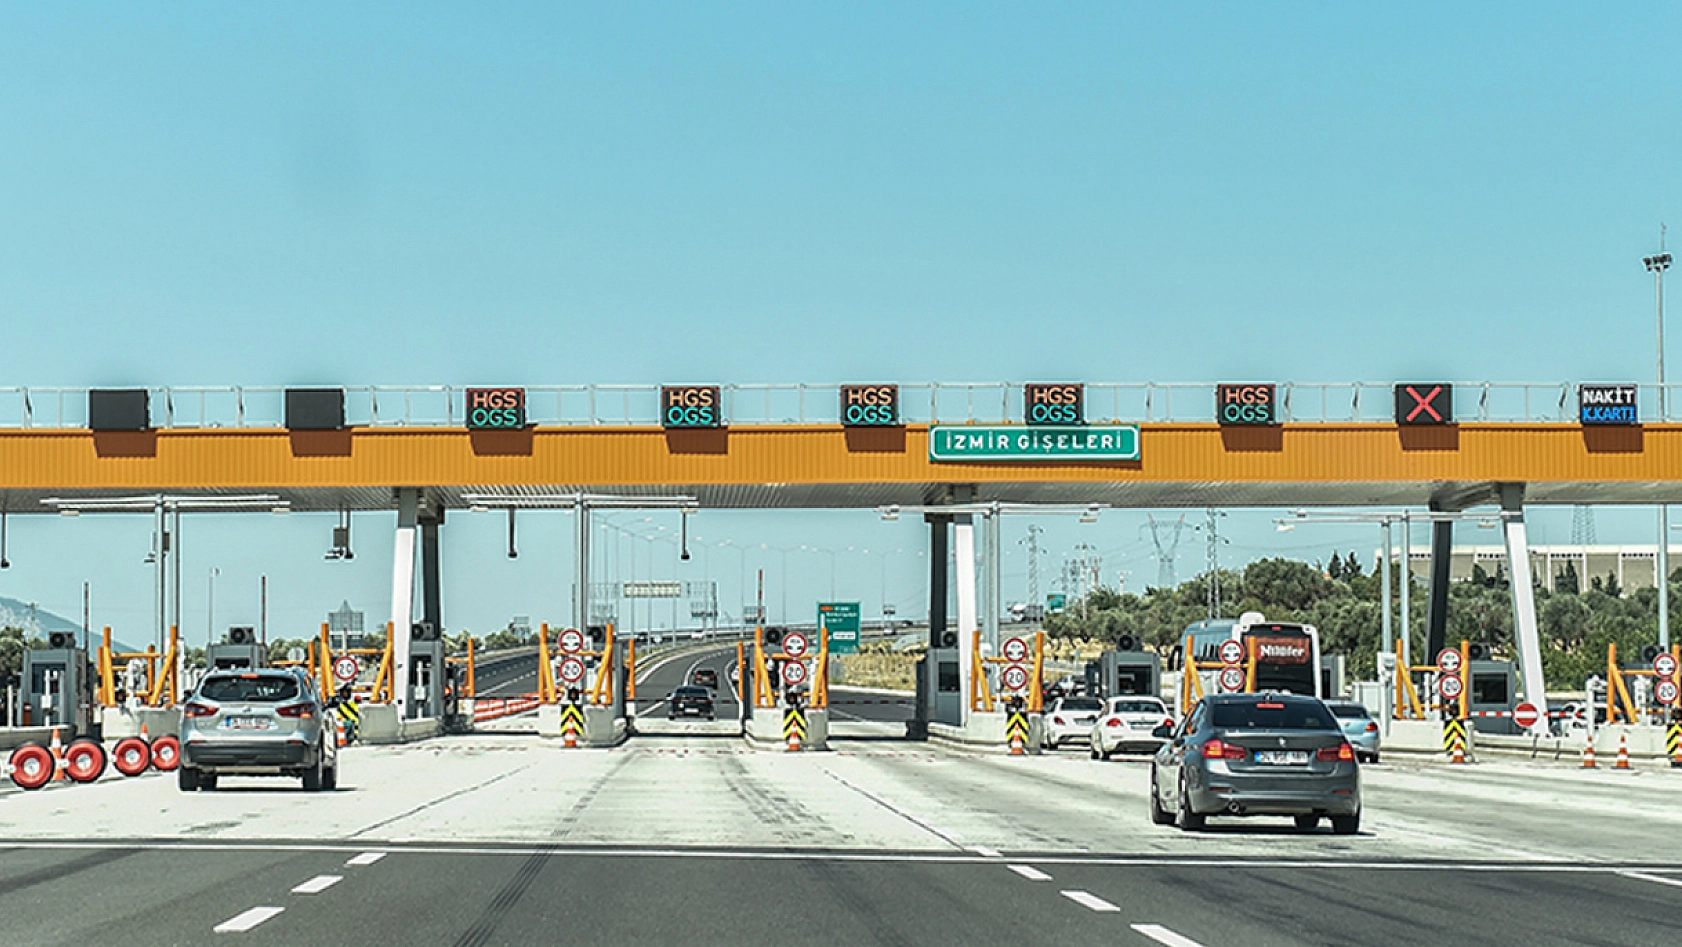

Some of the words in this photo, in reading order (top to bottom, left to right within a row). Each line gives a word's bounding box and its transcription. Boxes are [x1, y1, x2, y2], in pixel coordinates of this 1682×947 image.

[473, 391, 517, 408] HGS
[670, 389, 713, 406] HGS
[848, 388, 892, 405] HGS
[1033, 387, 1076, 404] HGS
[1225, 387, 1269, 404] HGS
[1583, 386, 1634, 403] NAKİT
[472, 408, 517, 426] OGS
[668, 406, 713, 425] OGS
[847, 405, 892, 423] OGS
[1032, 403, 1076, 422] OGS
[1224, 403, 1269, 422] OGS
[946, 430, 1010, 450] İZMİR
[1017, 430, 1122, 453] GİŞELERİ
[339, 663, 354, 674] 20
[565, 663, 580, 675] 20
[788, 666, 802, 678] 20
[1009, 671, 1023, 683] 20
[1445, 680, 1459, 692] 20
[1661, 685, 1673, 697] 20
